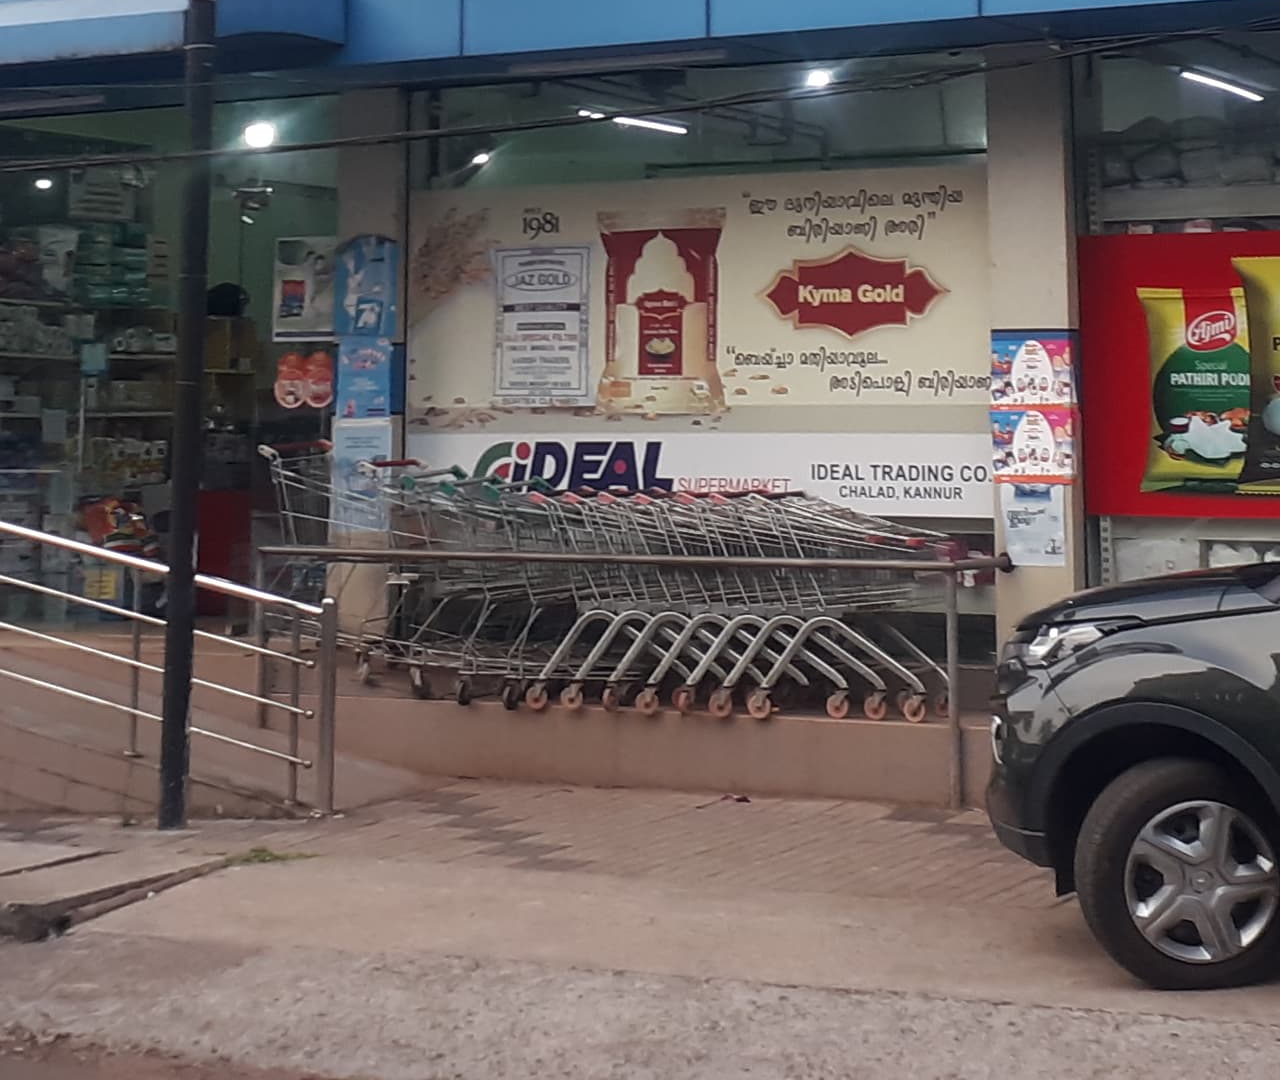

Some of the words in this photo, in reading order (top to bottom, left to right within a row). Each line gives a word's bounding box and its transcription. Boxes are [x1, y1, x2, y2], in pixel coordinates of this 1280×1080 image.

[522, 212, 560, 240] 1981
[538, 272, 571, 286] GOLD
[798, 285, 852, 307] Kyma
[857, 283, 905, 303] Gold
[1191, 313, 1232, 343] Ajmi
[918, 370, 992, 397] ബിരിയാണ
[1170, 372, 1219, 386] PATHIRI
[1220, 373, 1251, 386] PODI
[811, 463, 865, 482] IDEAL
[870, 464, 955, 483] TRADING
[960, 465, 993, 483] CO.
[839, 485, 900, 501] CHALAD,
[903, 486, 963, 501] KANNUR
